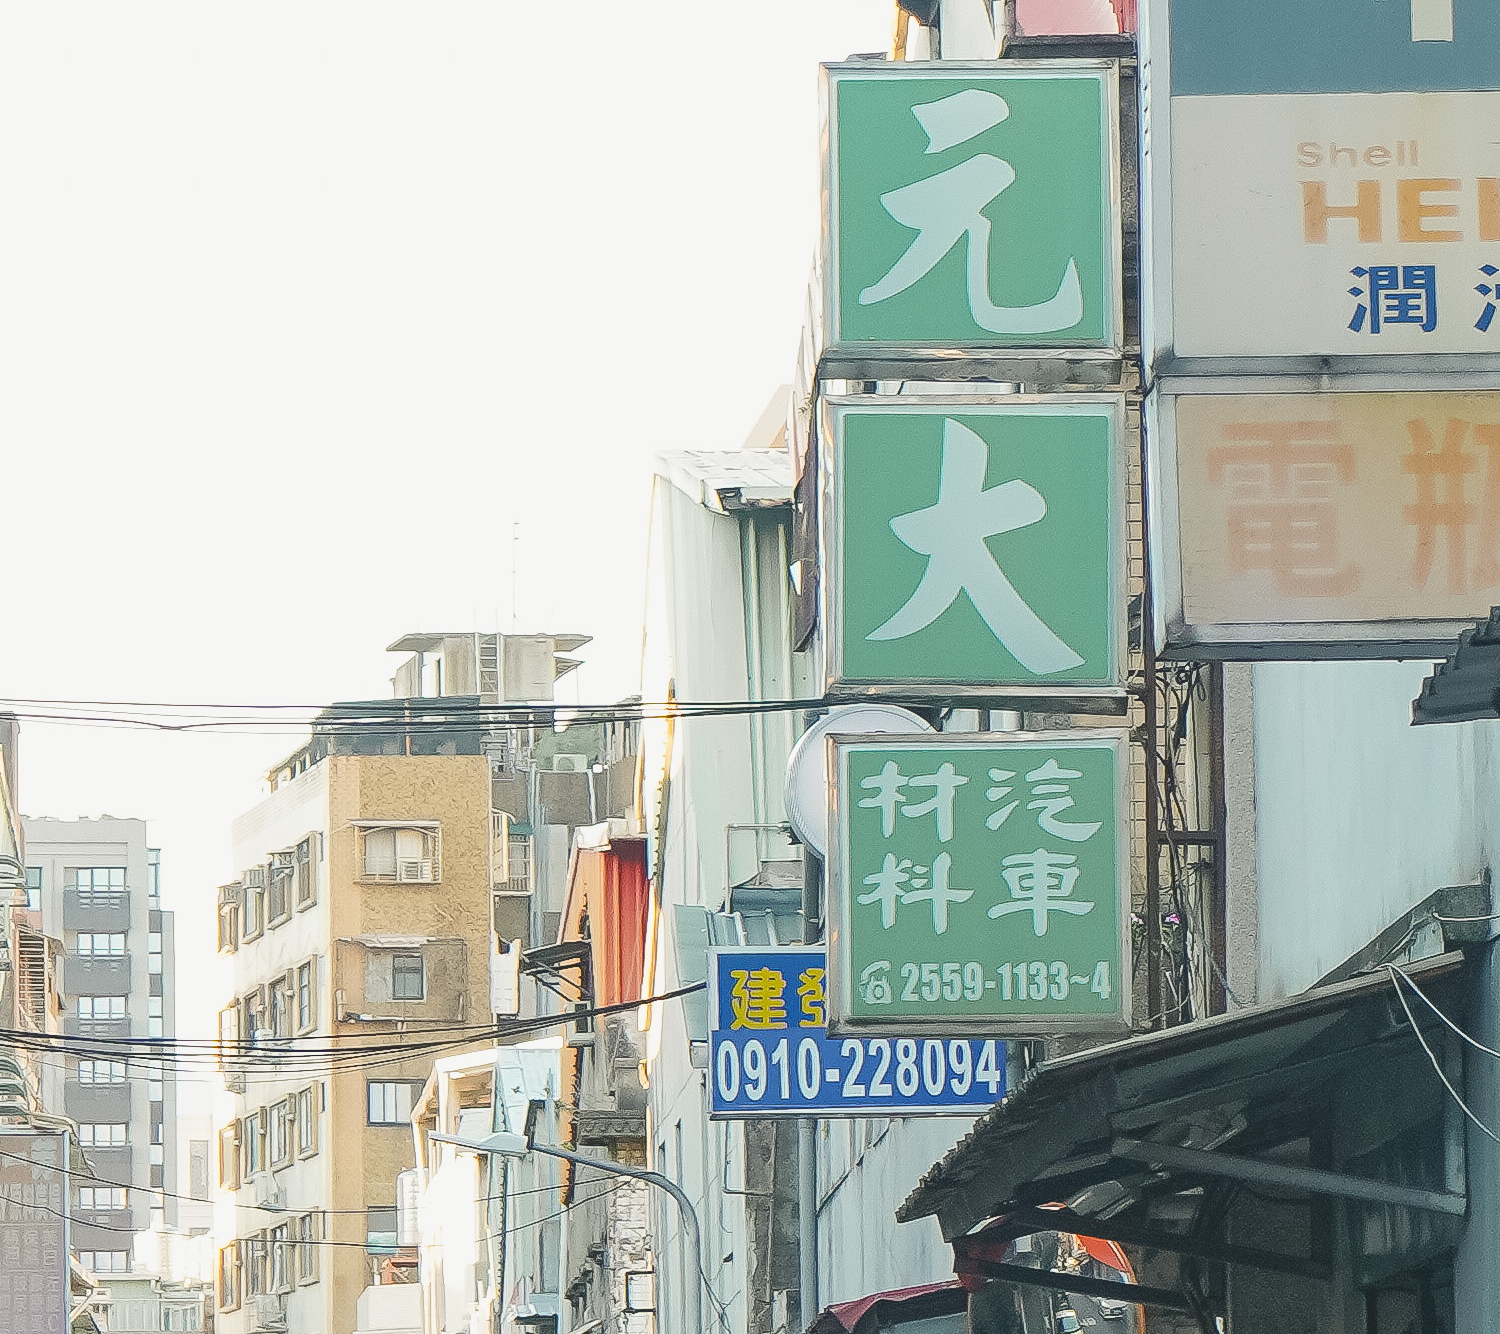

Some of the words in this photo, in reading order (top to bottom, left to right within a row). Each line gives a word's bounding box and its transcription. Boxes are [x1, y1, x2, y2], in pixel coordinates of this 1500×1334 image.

[858, 90, 1084, 334] 元
[1297, 140, 1420, 169] Shell
[865, 417, 1086, 676] 大
[857, 762, 975, 936] 材料
[986, 758, 1103, 938] 汽車
[716, 1037, 1001, 1103] 0910-228094
